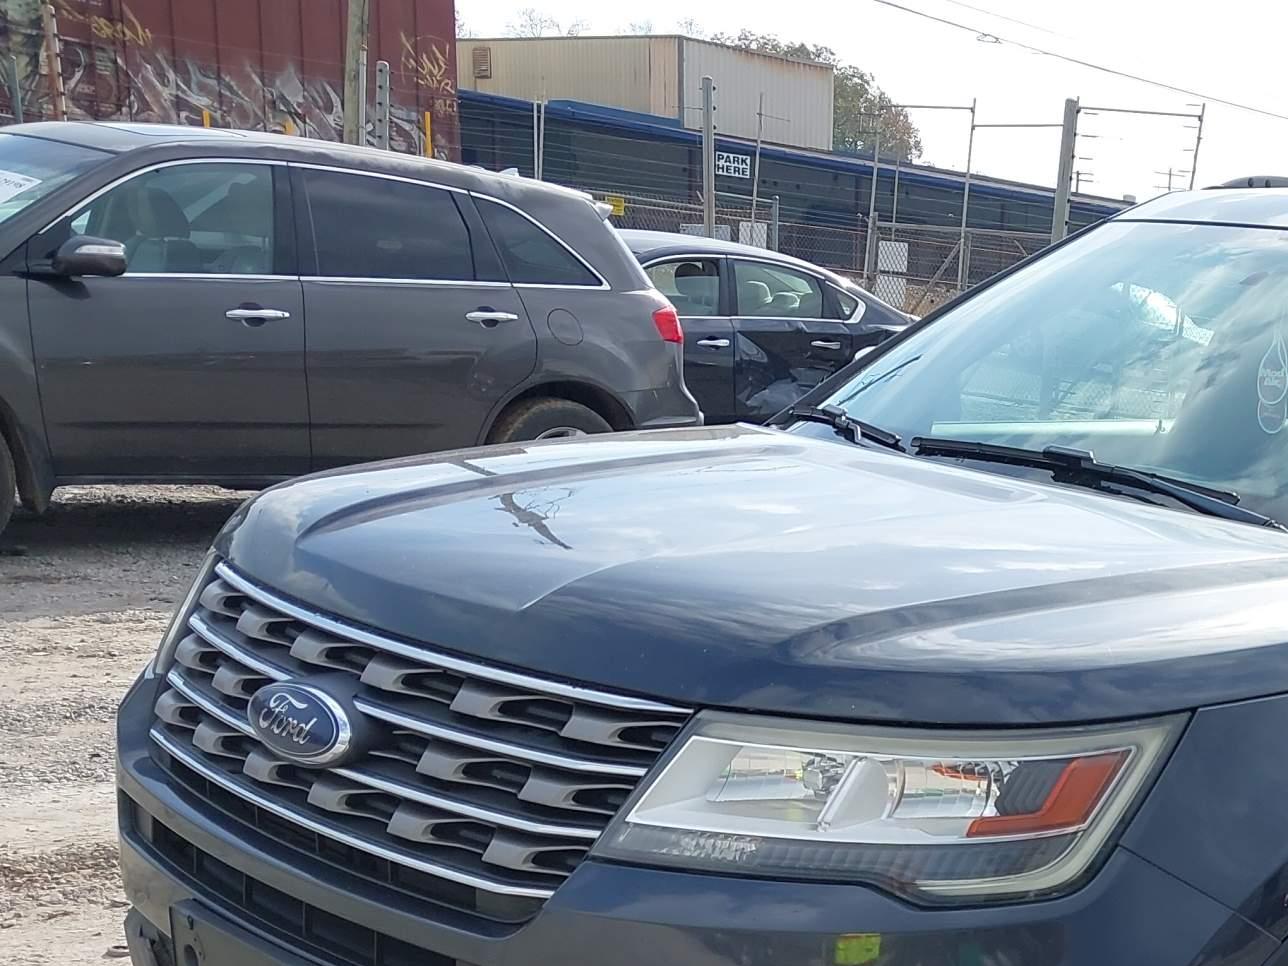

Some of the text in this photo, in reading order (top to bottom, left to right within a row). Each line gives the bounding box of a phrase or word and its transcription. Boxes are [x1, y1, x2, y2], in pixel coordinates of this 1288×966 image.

[717, 153, 749, 166] PARK
[717, 163, 749, 177] HERE
[259, 692, 318, 745] Ford
